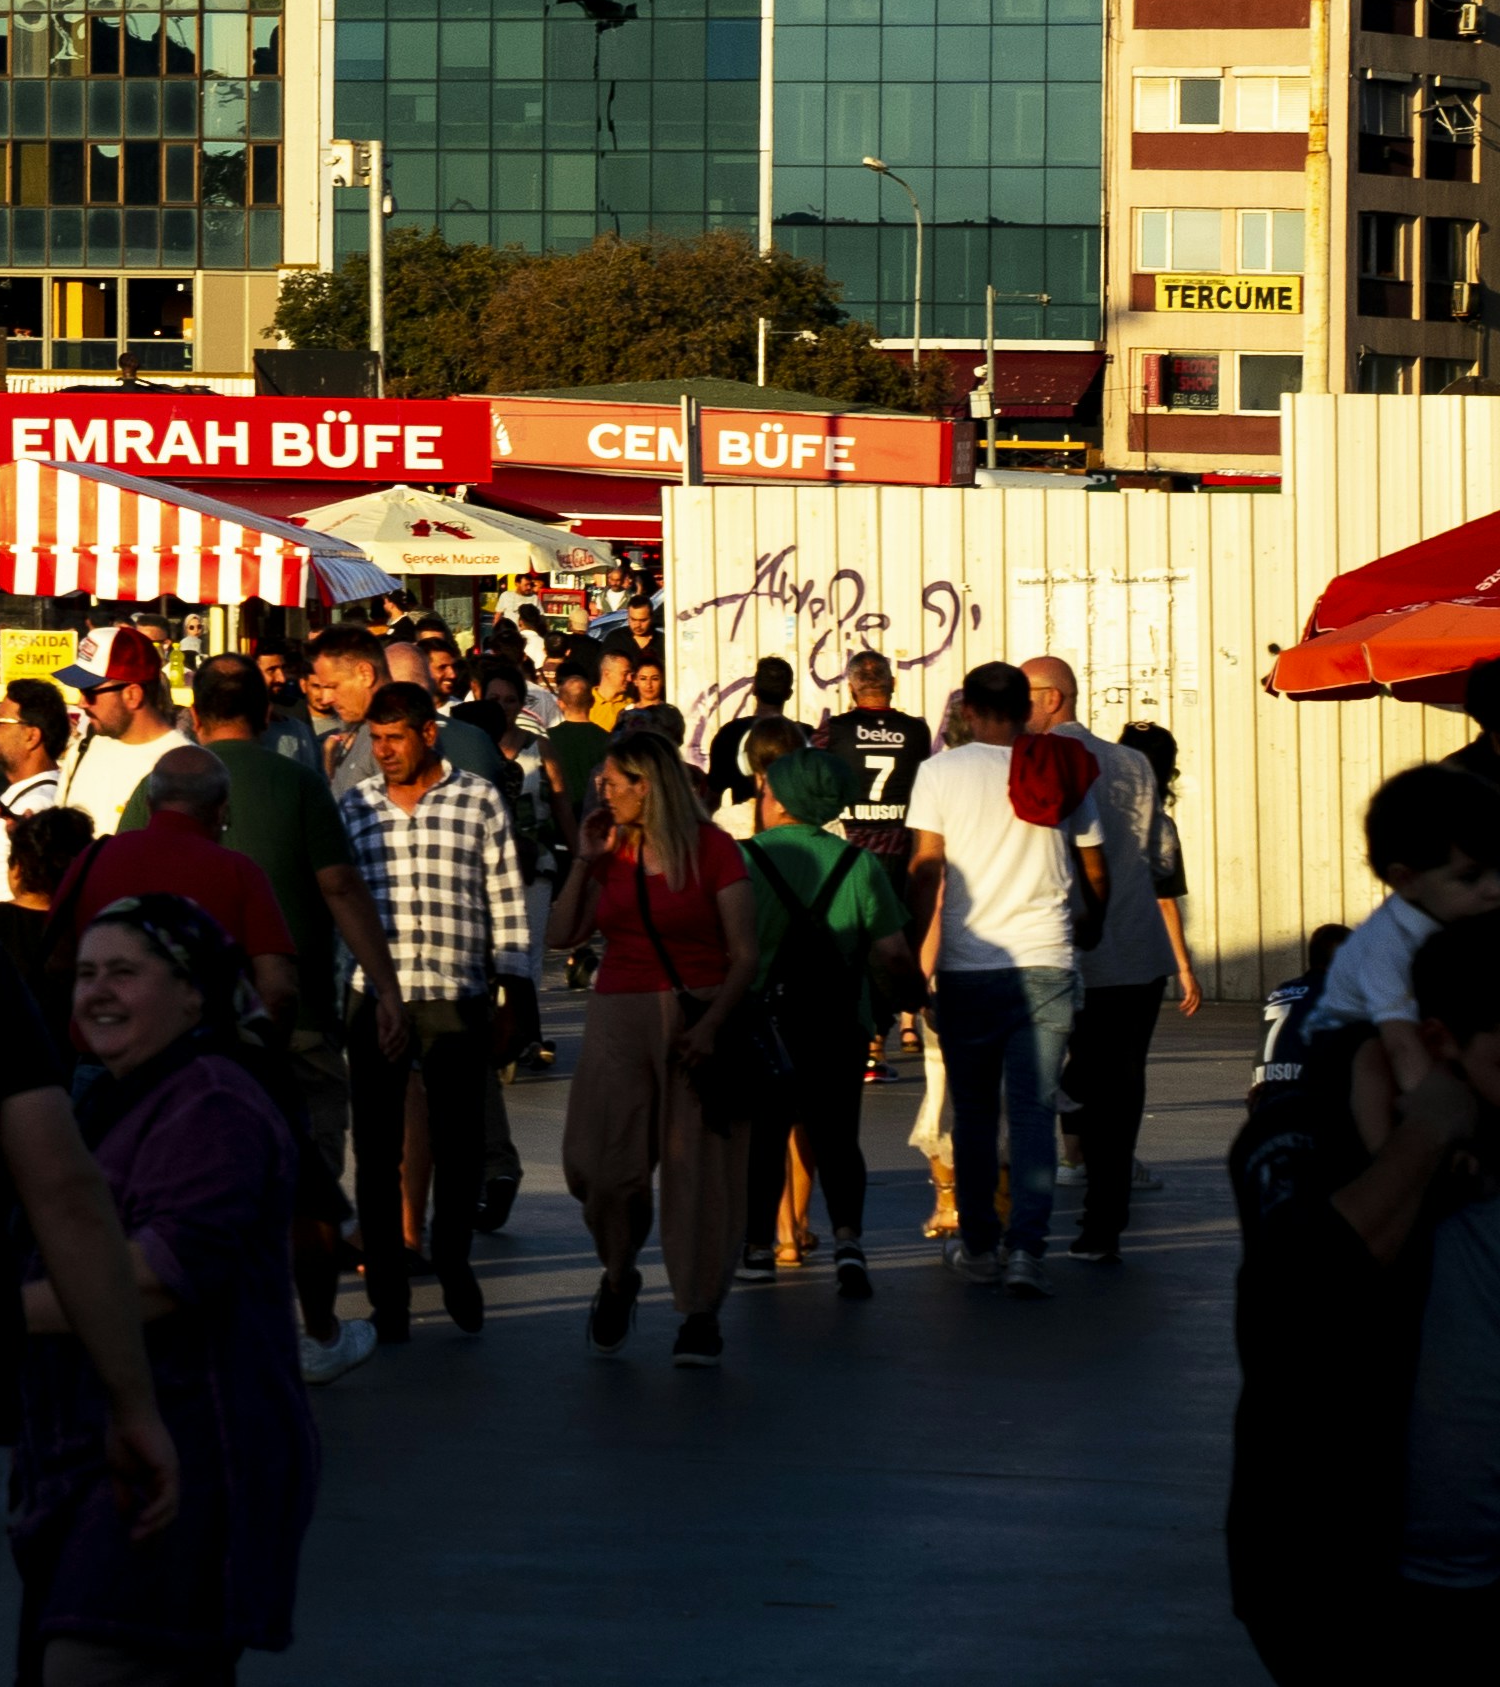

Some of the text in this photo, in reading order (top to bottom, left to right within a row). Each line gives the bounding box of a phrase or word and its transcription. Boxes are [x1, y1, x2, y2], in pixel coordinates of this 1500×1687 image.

[1165, 281, 1293, 310] TERCÜME
[1179, 376, 1213, 391] SHOP
[11, 410, 444, 471] EMRAH BÜFE
[717, 421, 857, 472] BÜFE
[402, 553, 500, 567] Gerçek Mucize
[8, 635, 70, 648] ASKIDA
[15, 651, 62, 665] SİMİT
[856, 725, 905, 744] beko
[864, 755, 896, 802] 7
[854, 804, 906, 820] ULUSOY
[1263, 1003, 1292, 1063] 7
